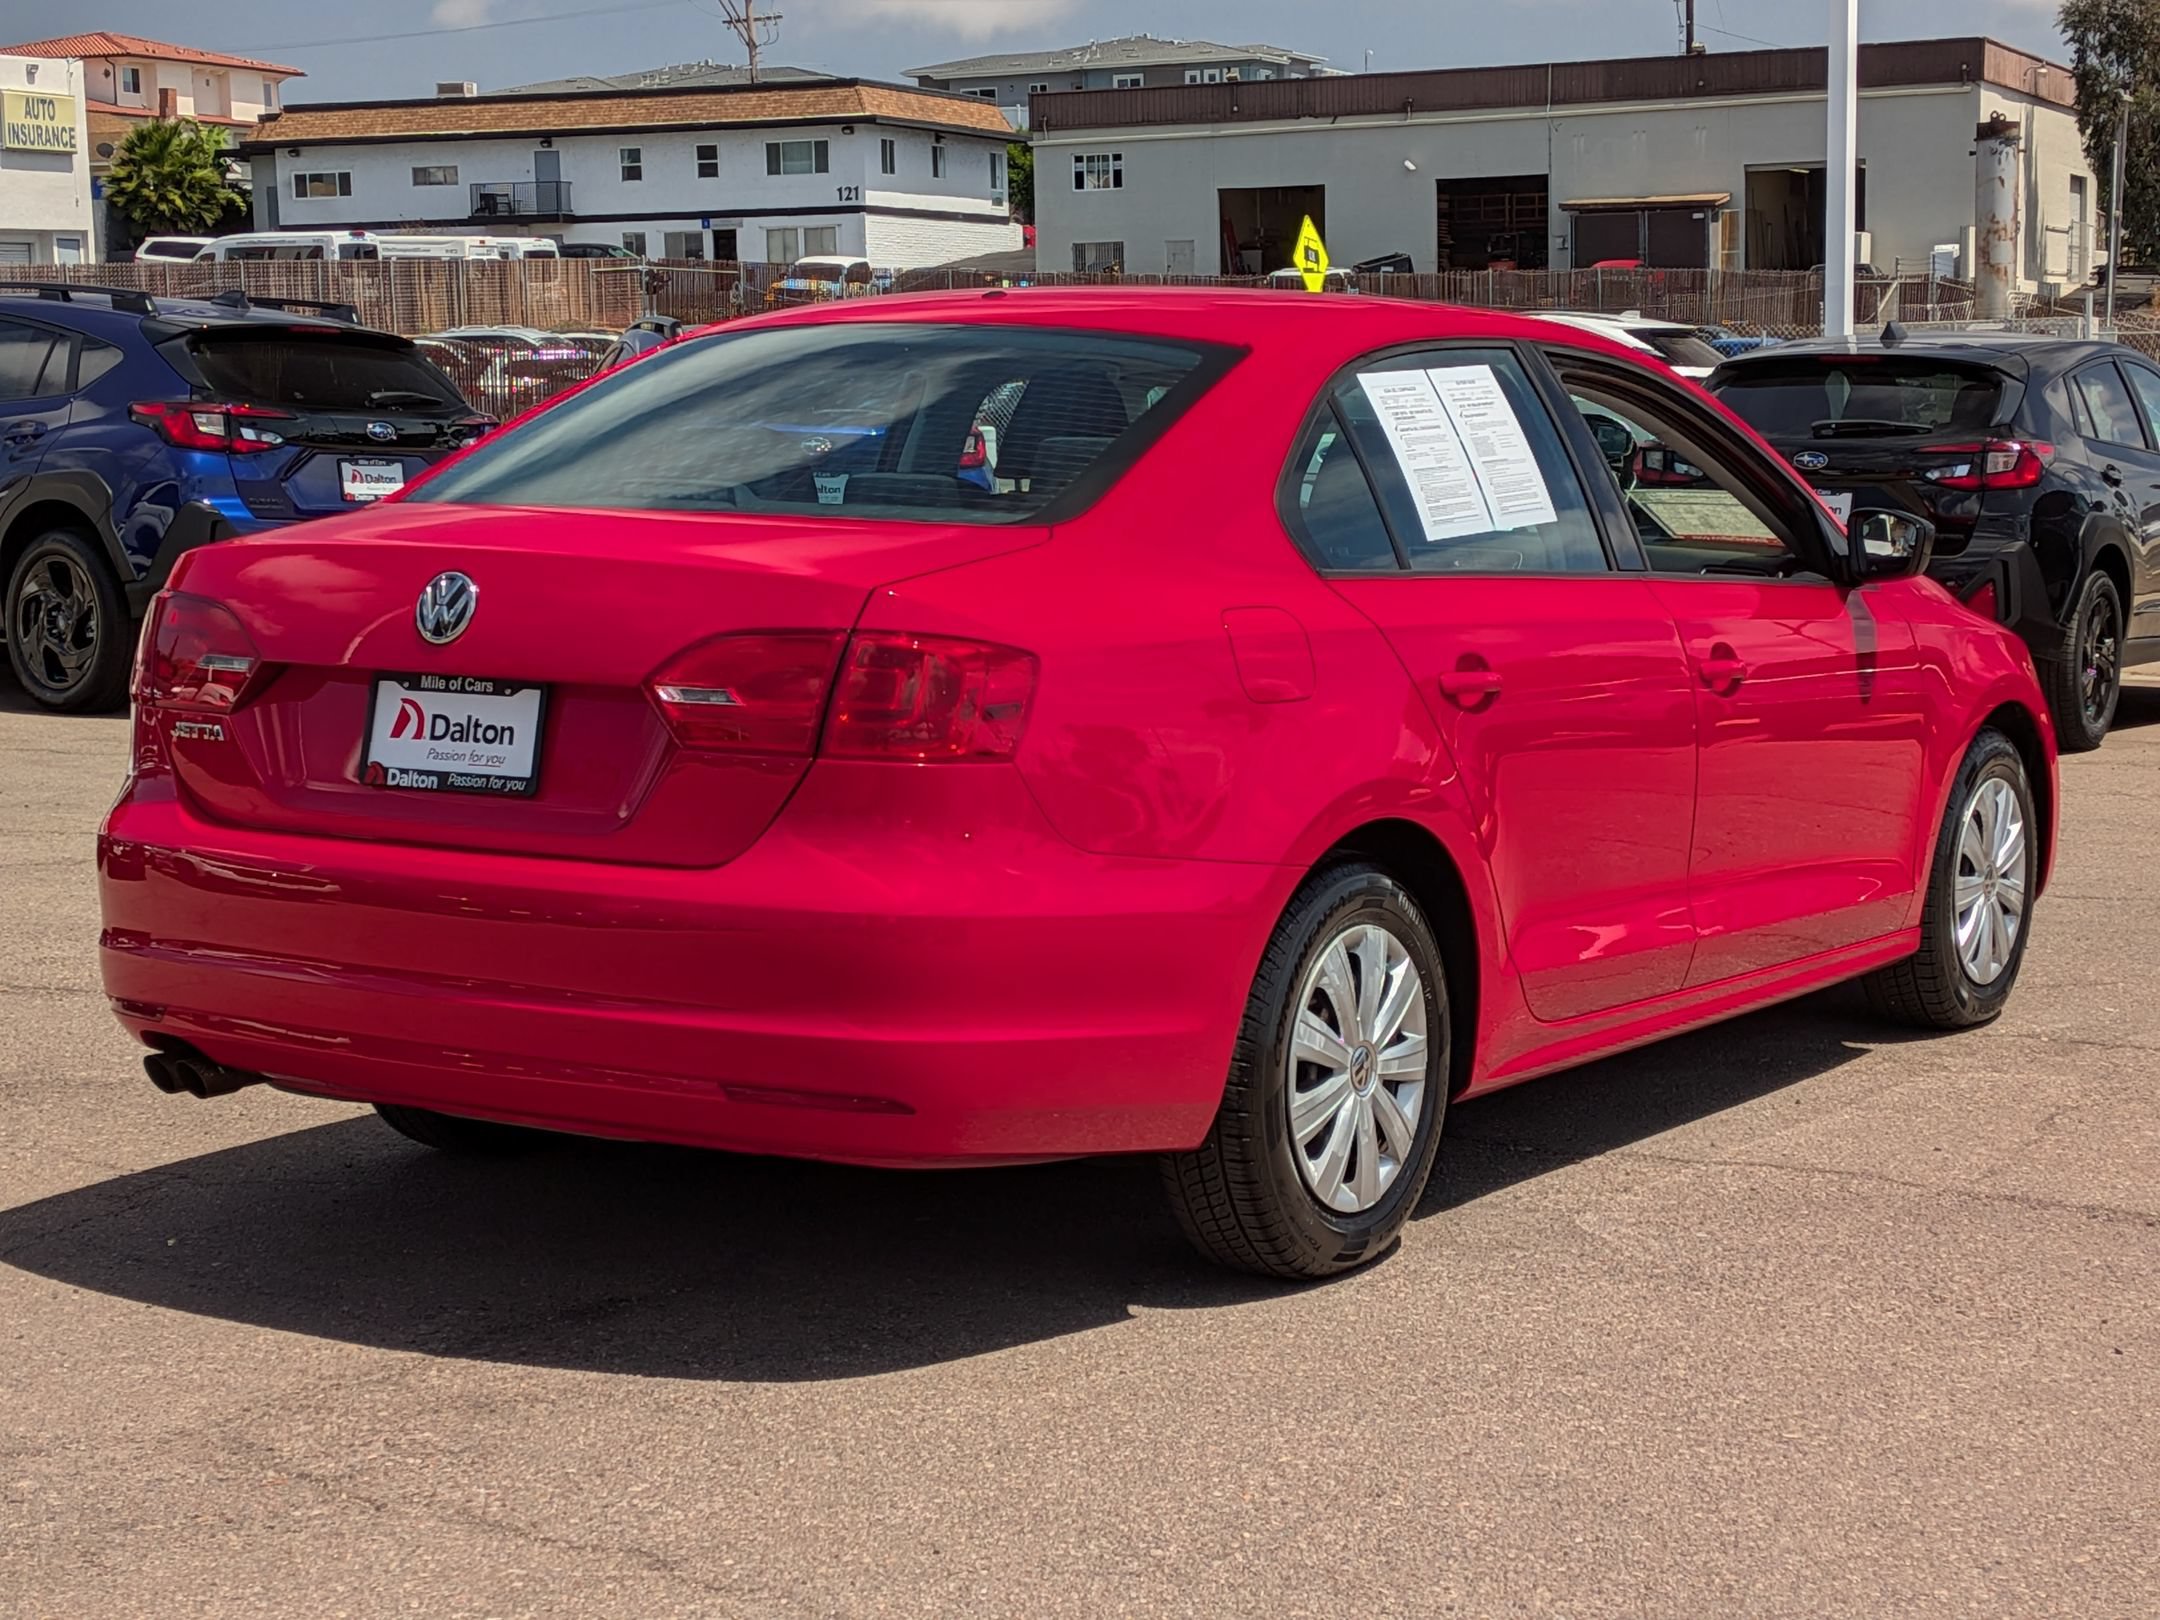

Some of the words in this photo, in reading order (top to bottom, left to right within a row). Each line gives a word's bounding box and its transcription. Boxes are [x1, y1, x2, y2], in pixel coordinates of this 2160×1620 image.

[24, 96, 56, 121] AUTO
[7, 122, 76, 148] INSURANCE
[836, 185, 859, 201] 121
[364, 474, 397, 484] Dalton
[420, 675, 446, 690] Mile
[449, 677, 463, 691] of
[464, 677, 494, 693] Cars
[429, 713, 515, 746] Dalton
[426, 747, 466, 762] Passion
[467, 749, 484, 763] for
[485, 754, 507, 766] you
[386, 768, 438, 789] Dalton
[447, 772, 487, 789] Passion
[486, 776, 503, 790] for
[502, 779, 527, 792] you
